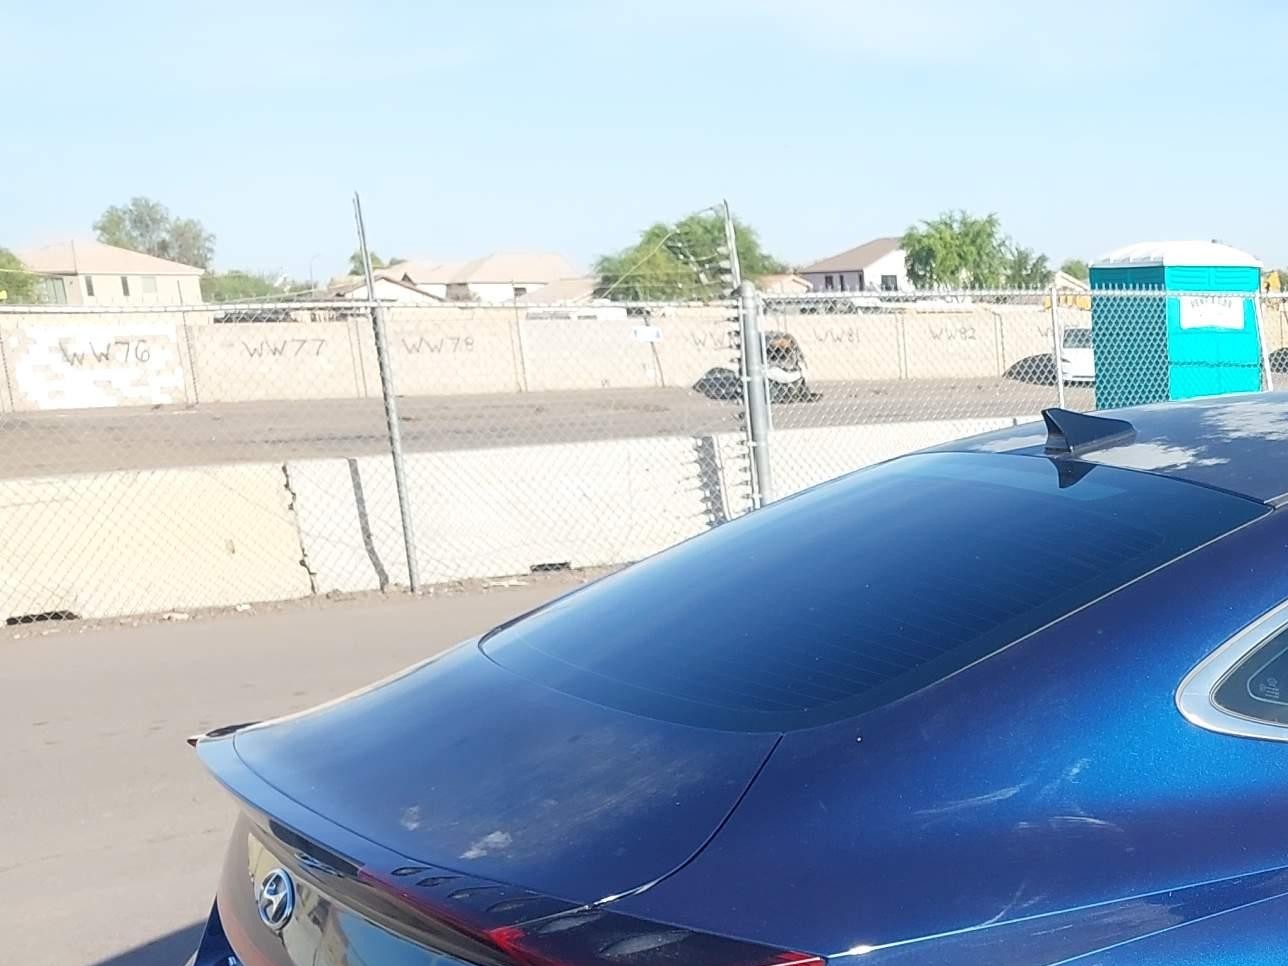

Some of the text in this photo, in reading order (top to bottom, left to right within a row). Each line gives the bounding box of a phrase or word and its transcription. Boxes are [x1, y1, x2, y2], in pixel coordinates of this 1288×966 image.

[58, 339, 151, 366] WW76
[241, 338, 326, 358] WW77
[401, 336, 474, 354] WW78
